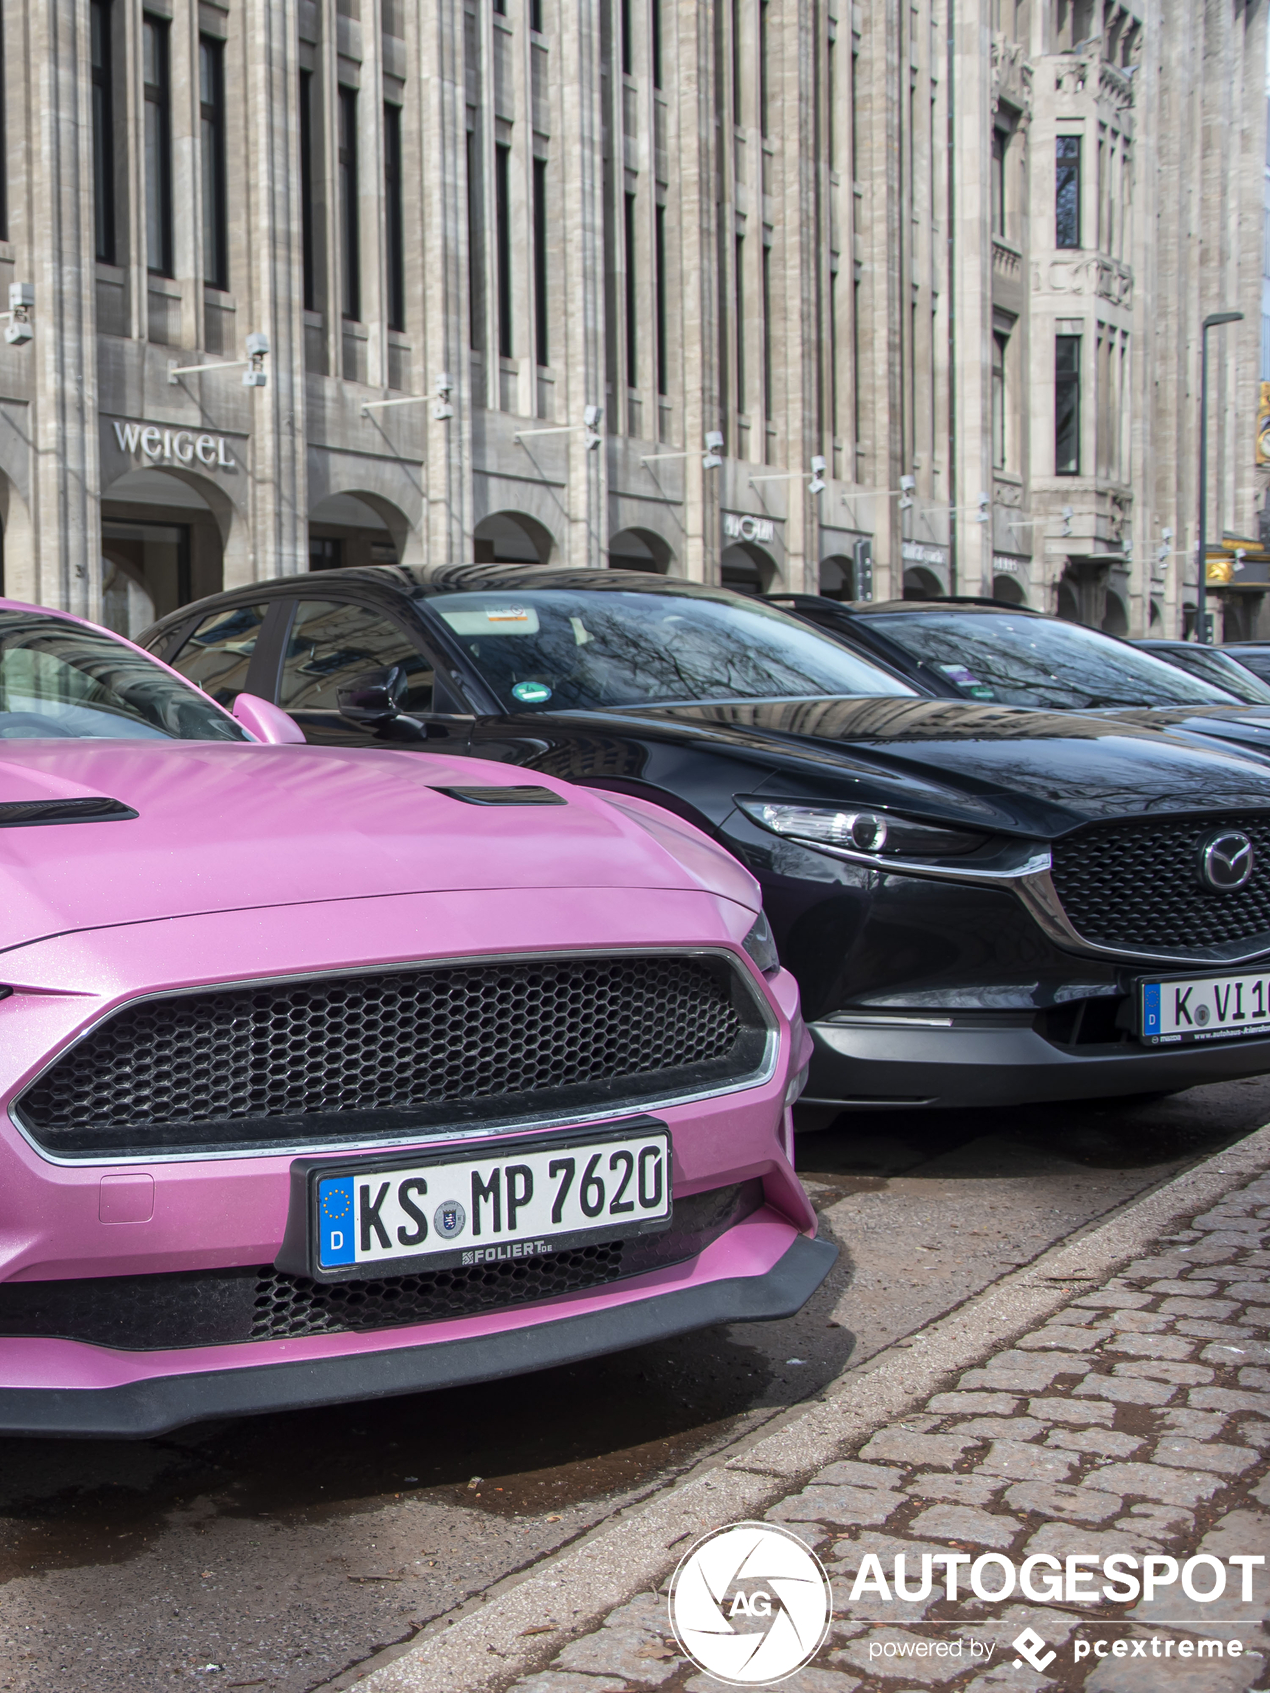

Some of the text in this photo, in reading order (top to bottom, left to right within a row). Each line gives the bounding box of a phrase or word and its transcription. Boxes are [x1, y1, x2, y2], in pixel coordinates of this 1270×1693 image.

[1175, 986, 1193, 1026] K
[1252, 980, 1270, 1018] 1
[1149, 1014, 1156, 1025] D
[359, 1177, 428, 1251] KS
[471, 1164, 534, 1236] MP
[549, 1145, 663, 1224] 7620
[331, 1231, 344, 1250] D
